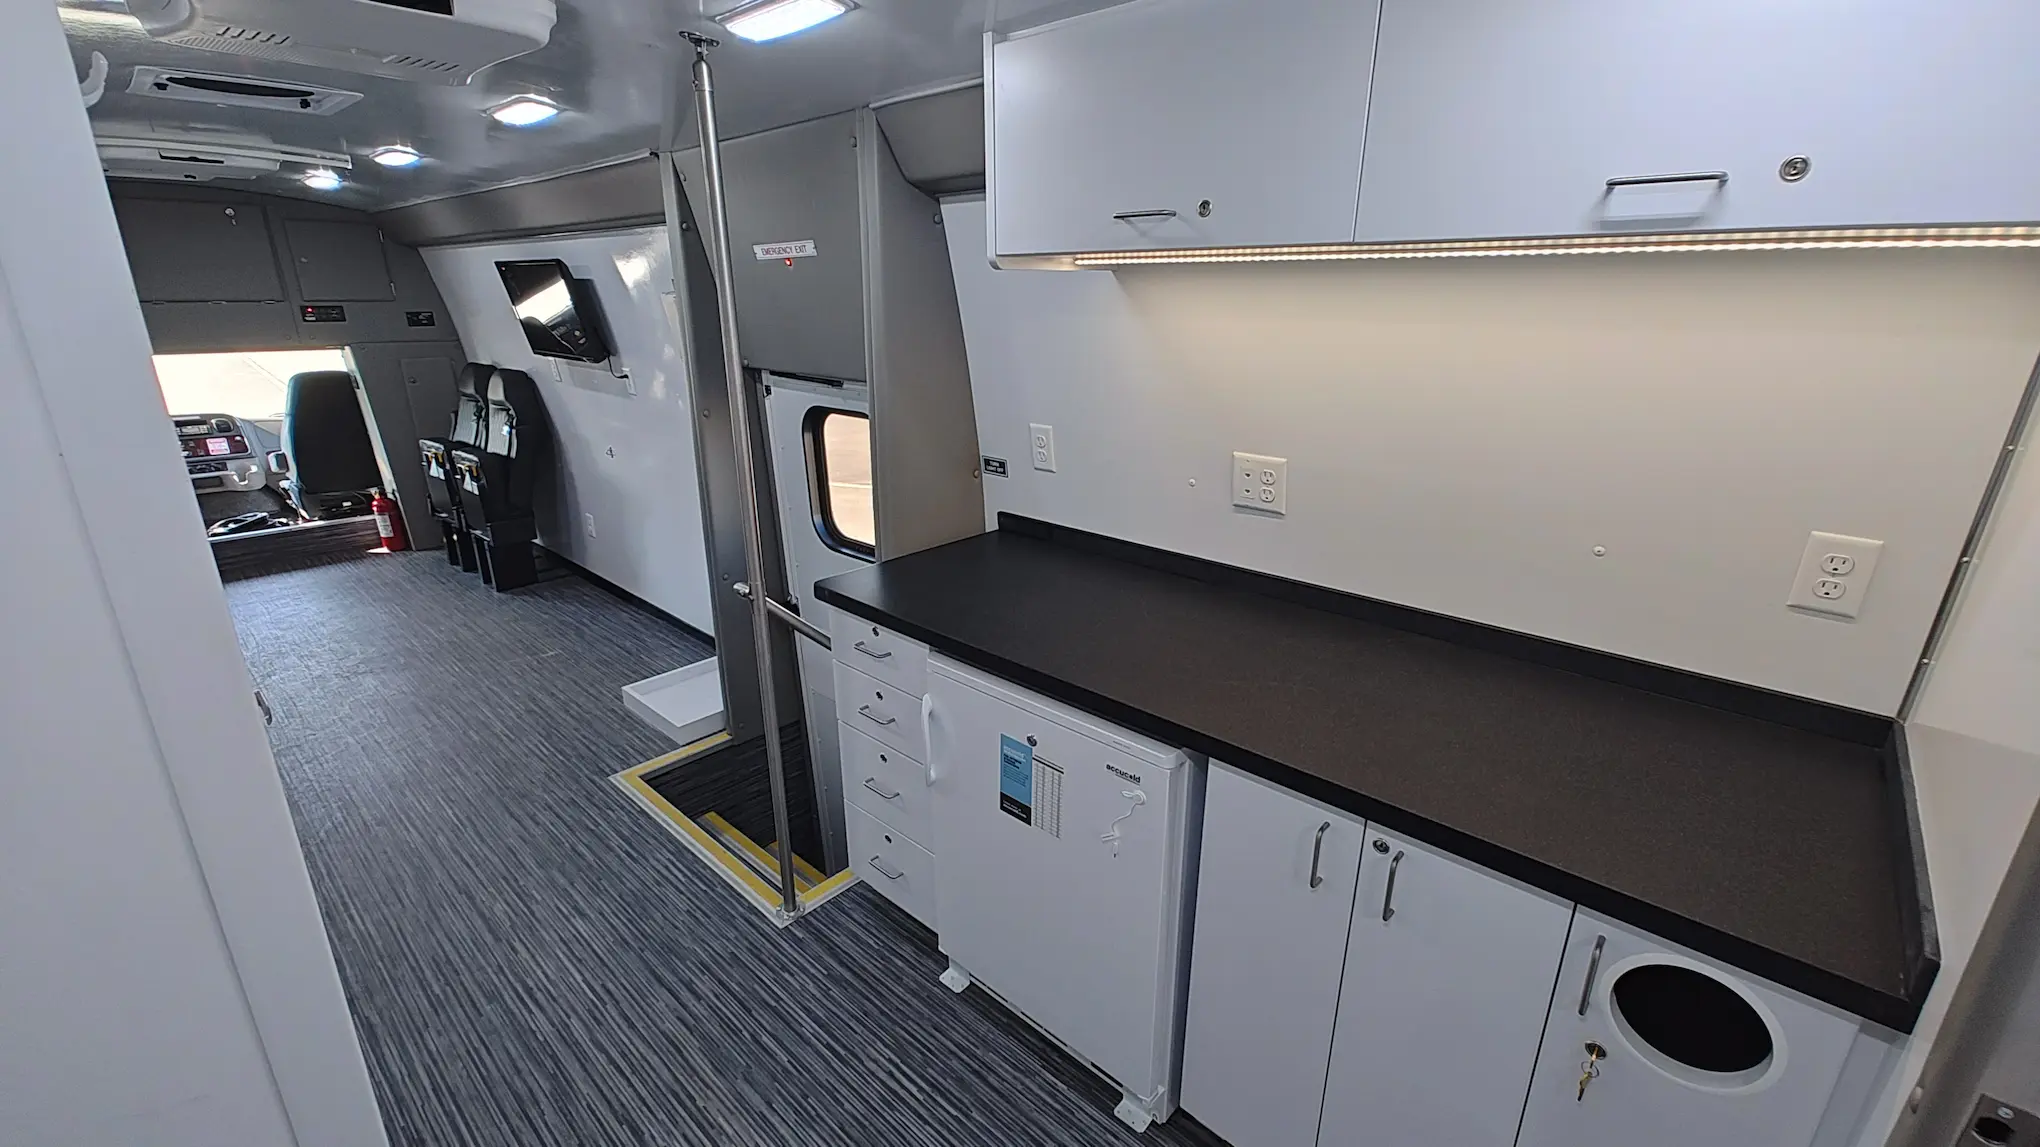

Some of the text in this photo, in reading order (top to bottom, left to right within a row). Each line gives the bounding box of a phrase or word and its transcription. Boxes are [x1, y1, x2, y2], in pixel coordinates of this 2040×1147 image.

[761, 244, 807, 256] EMERGENCY EXIT
[1105, 764, 1141, 784] accucold
